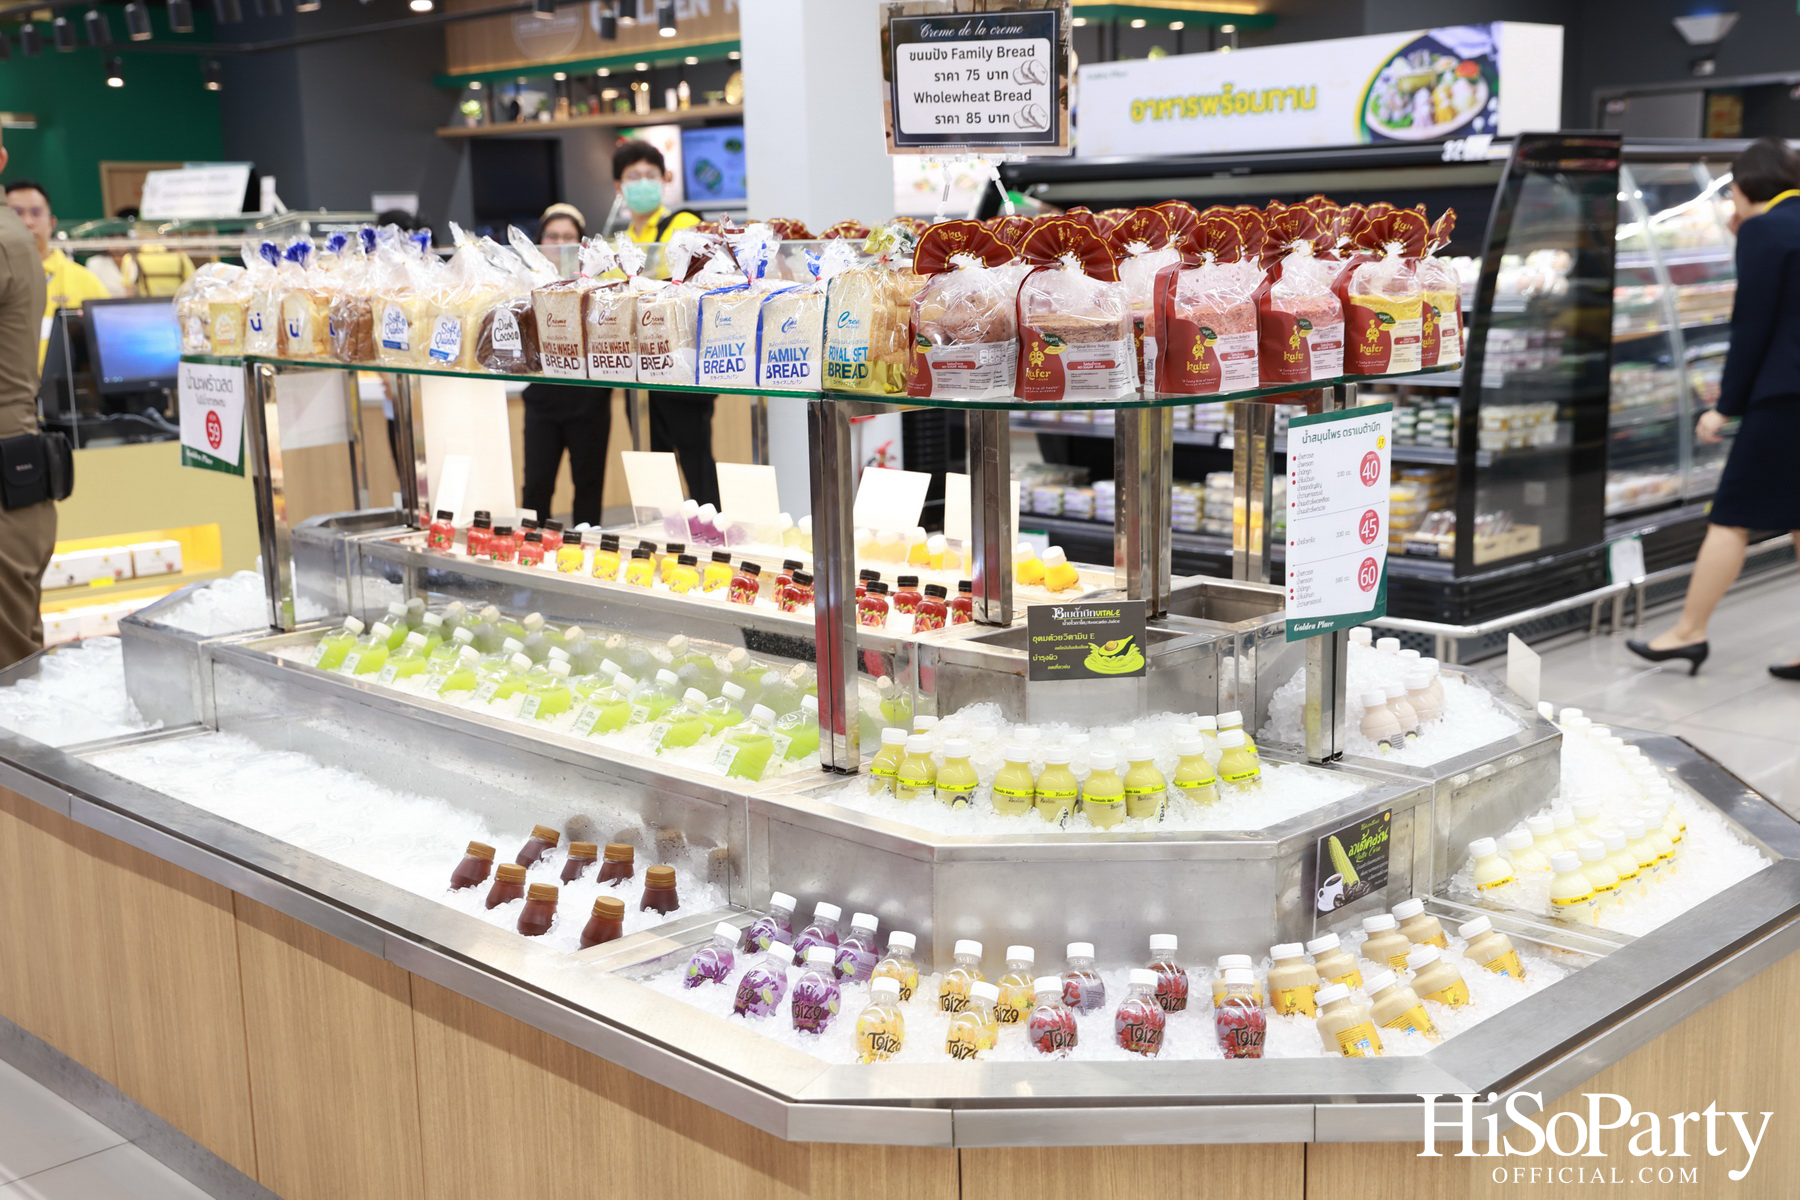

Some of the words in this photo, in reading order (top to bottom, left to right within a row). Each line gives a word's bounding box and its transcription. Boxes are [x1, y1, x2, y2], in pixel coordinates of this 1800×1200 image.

[920, 24, 955, 38] Creme
[958, 20, 971, 36] de
[975, 19, 987, 35] la
[990, 24, 1023, 35] creme
[909, 48, 948, 61] ขนมปัง
[951, 46, 993, 62] Family
[997, 45, 1035, 58] Bread
[934, 70, 960, 82] ราคา
[966, 69, 980, 81] 75
[987, 69, 1009, 80] บาท
[914, 90, 990, 104] Wholewheat
[994, 89, 1032, 101] Bread
[1130, 82, 1317, 124] อาหารพร้อมทาน
[935, 113, 960, 125] ราคา
[966, 112, 982, 124] 85
[988, 112, 1010, 123] บาท
[441, 321, 457, 335] Soft
[558, 344, 578, 356] WHEAT
[610, 341, 630, 354] WHEAT
[704, 342, 745, 359] FAMILY
[546, 355, 581, 370] BREAD
[593, 355, 633, 369] BREAD
[703, 358, 746, 374] BREAD
[766, 363, 810, 379] BREAD
[828, 363, 869, 379] BREAD
[207, 422, 221, 442] 59
[1302, 429, 1341, 444] น้ำสมุนไพร
[1362, 460, 1379, 480] 40
[1361, 518, 1377, 538] 45
[1361, 565, 1376, 587] 60
[1294, 621, 1315, 632] Golden
[1317, 620, 1334, 629] Place
